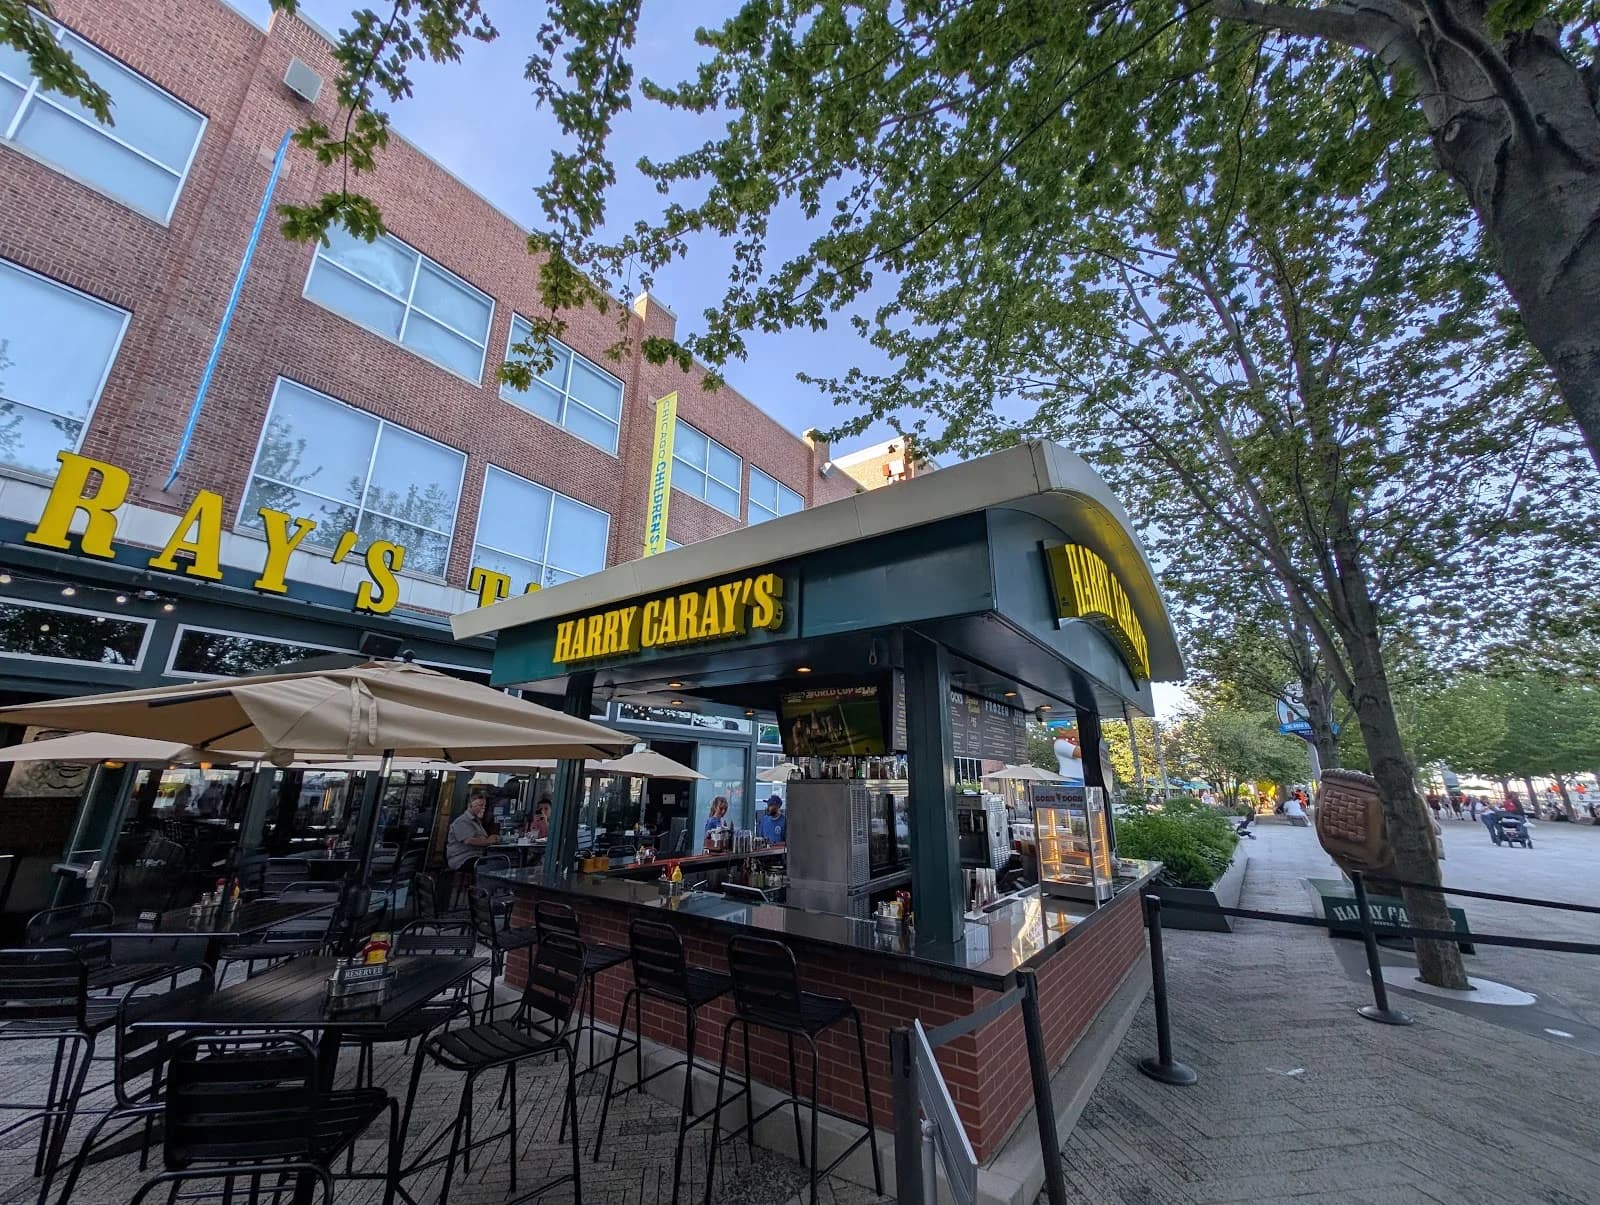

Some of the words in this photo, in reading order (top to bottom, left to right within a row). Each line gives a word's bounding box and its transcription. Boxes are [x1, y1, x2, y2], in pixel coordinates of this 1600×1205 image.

[658, 400, 670, 460] CHICAGO
[649, 460, 667, 545] CHILDREN'S
[470, 566, 542, 608] T
[1064, 543, 1115, 618] HARRY
[552, 606, 638, 664] HARRY
[640, 573, 782, 648] CARAY'S
[984, 700, 1010, 717] FROZEN
[344, 967, 384, 979] RESERVED
